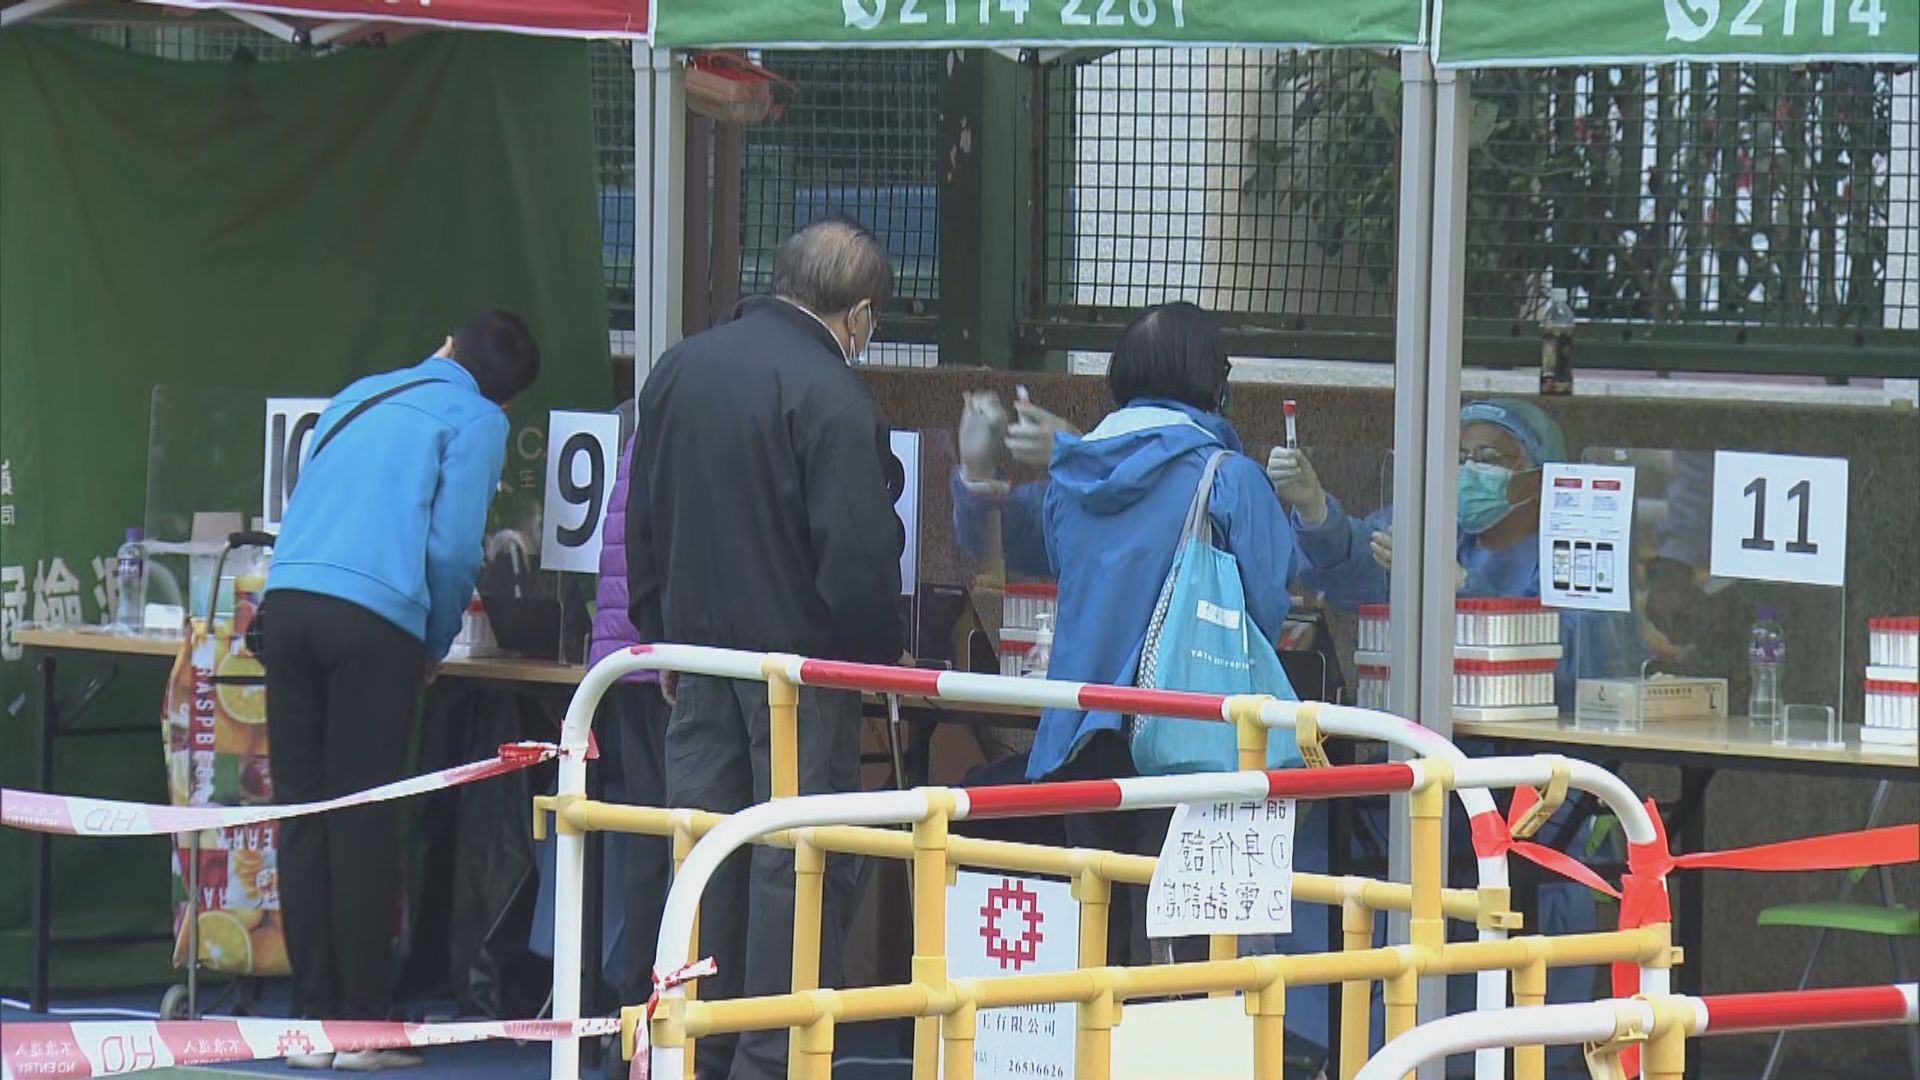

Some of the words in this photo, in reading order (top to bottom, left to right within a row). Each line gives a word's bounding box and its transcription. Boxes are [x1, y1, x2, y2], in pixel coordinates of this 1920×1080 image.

[556, 432, 605, 547] 9
[1740, 477, 1819, 554] 11
[1008, 1059, 1064, 1079] 26536626
